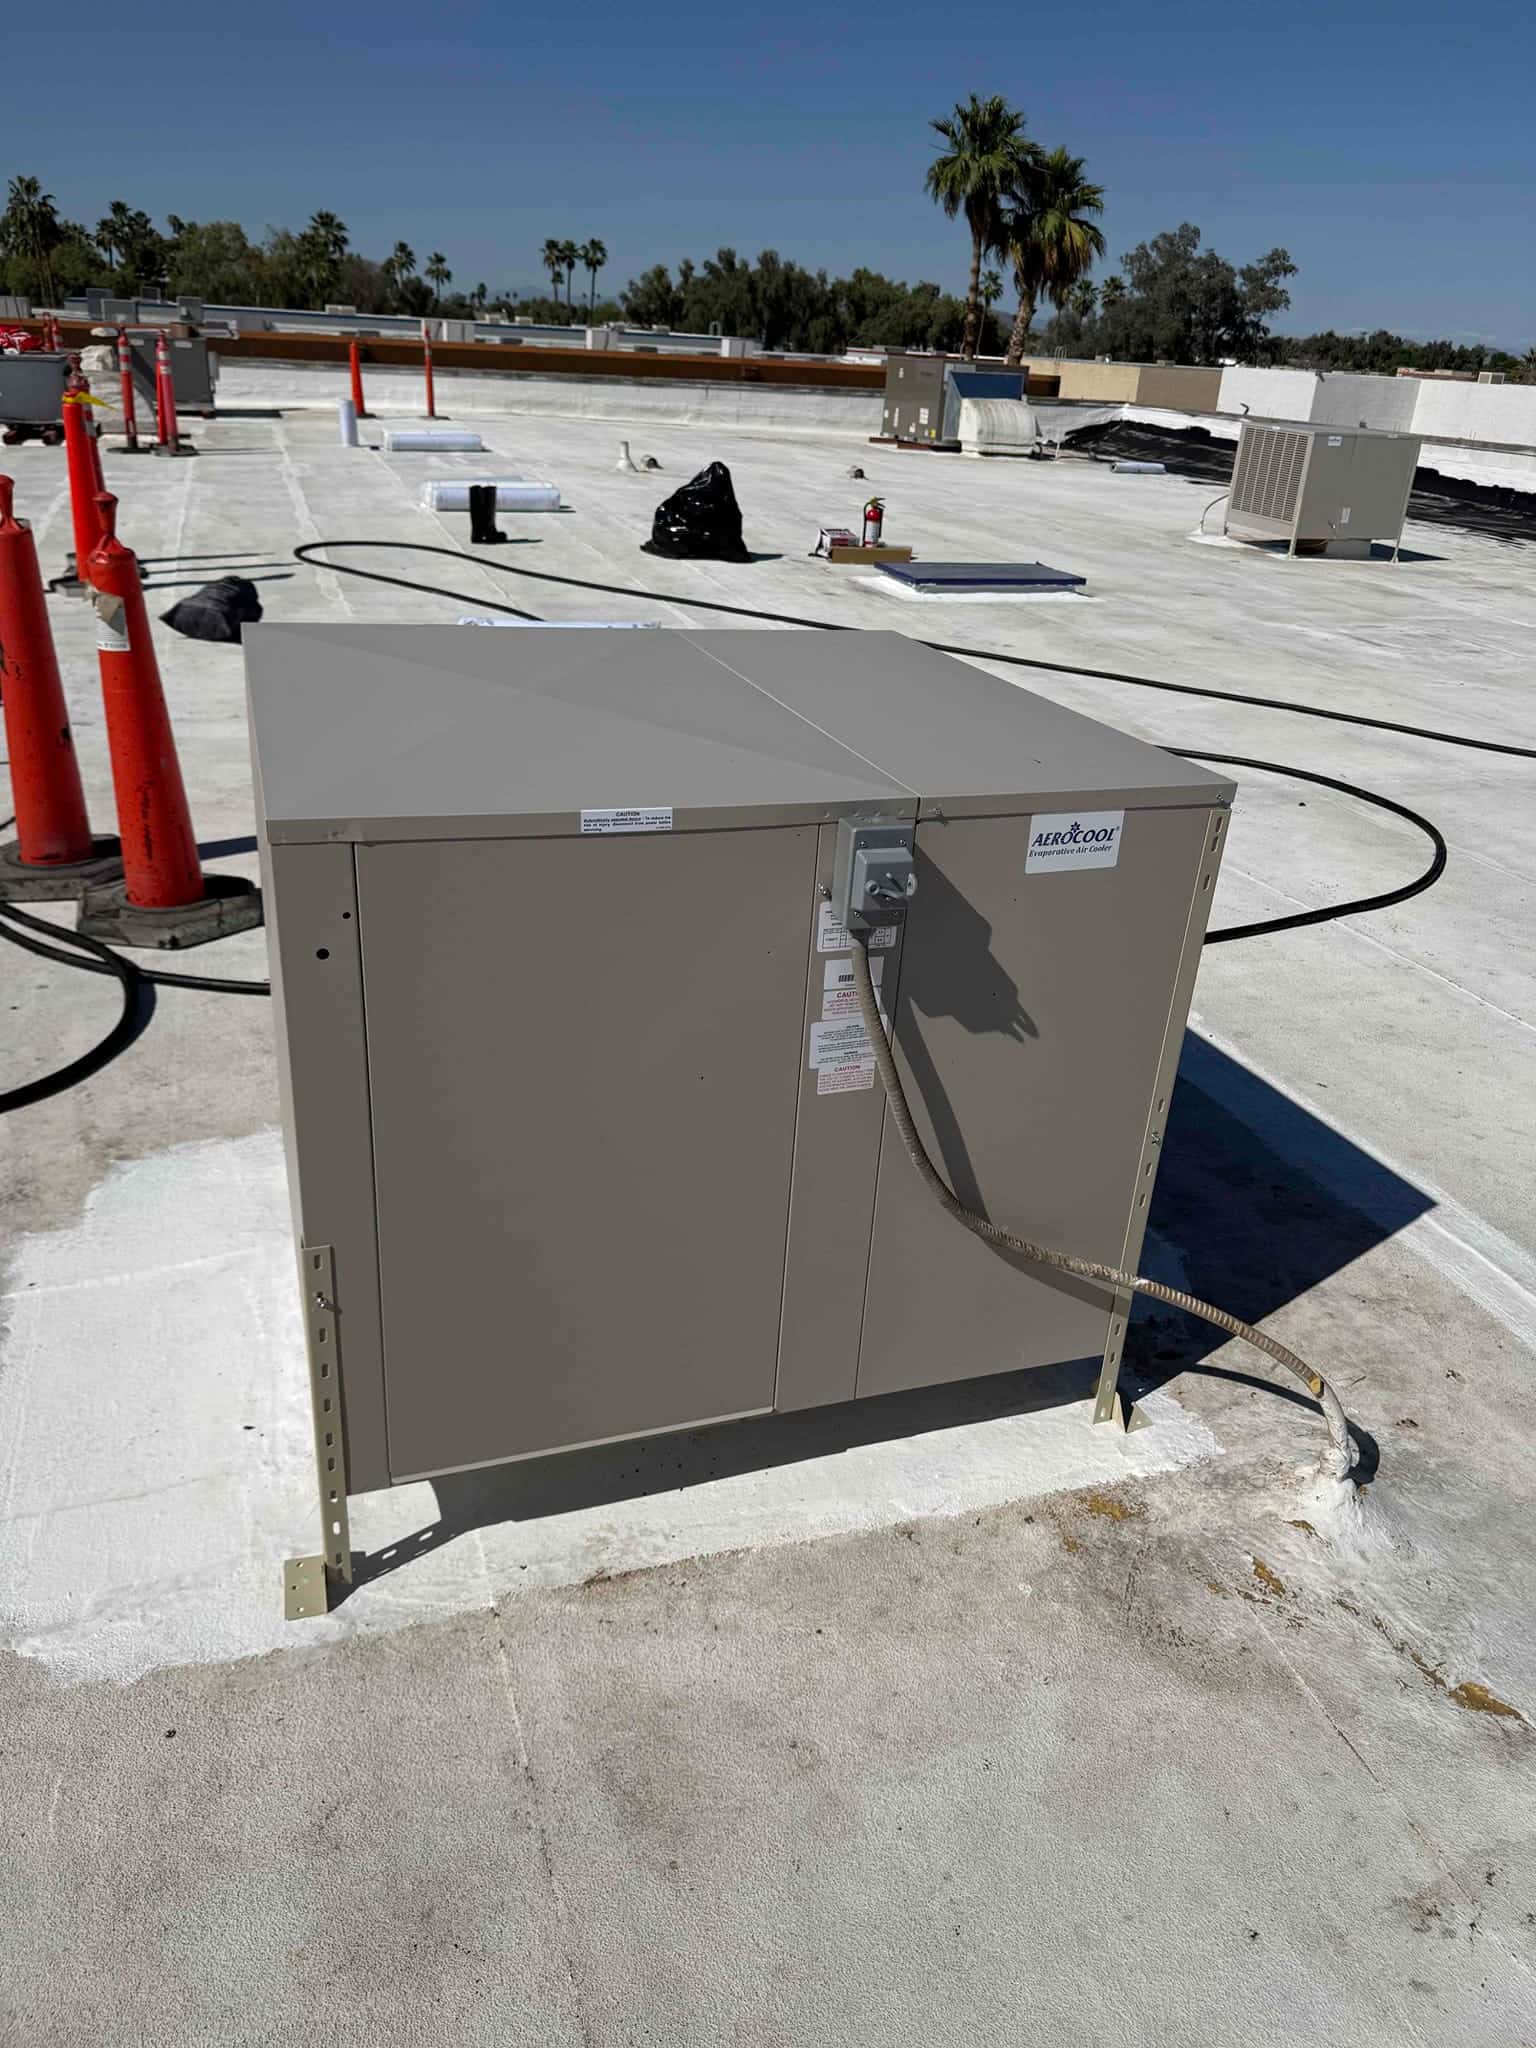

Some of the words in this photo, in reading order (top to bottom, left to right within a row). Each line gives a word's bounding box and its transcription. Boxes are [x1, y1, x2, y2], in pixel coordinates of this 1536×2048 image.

[1031, 828, 1115, 847] AEROCOOL
[1029, 848, 1075, 858] Evaporative
[1076, 846, 1088, 854] Air
[1089, 845, 1112, 853] Cooler
